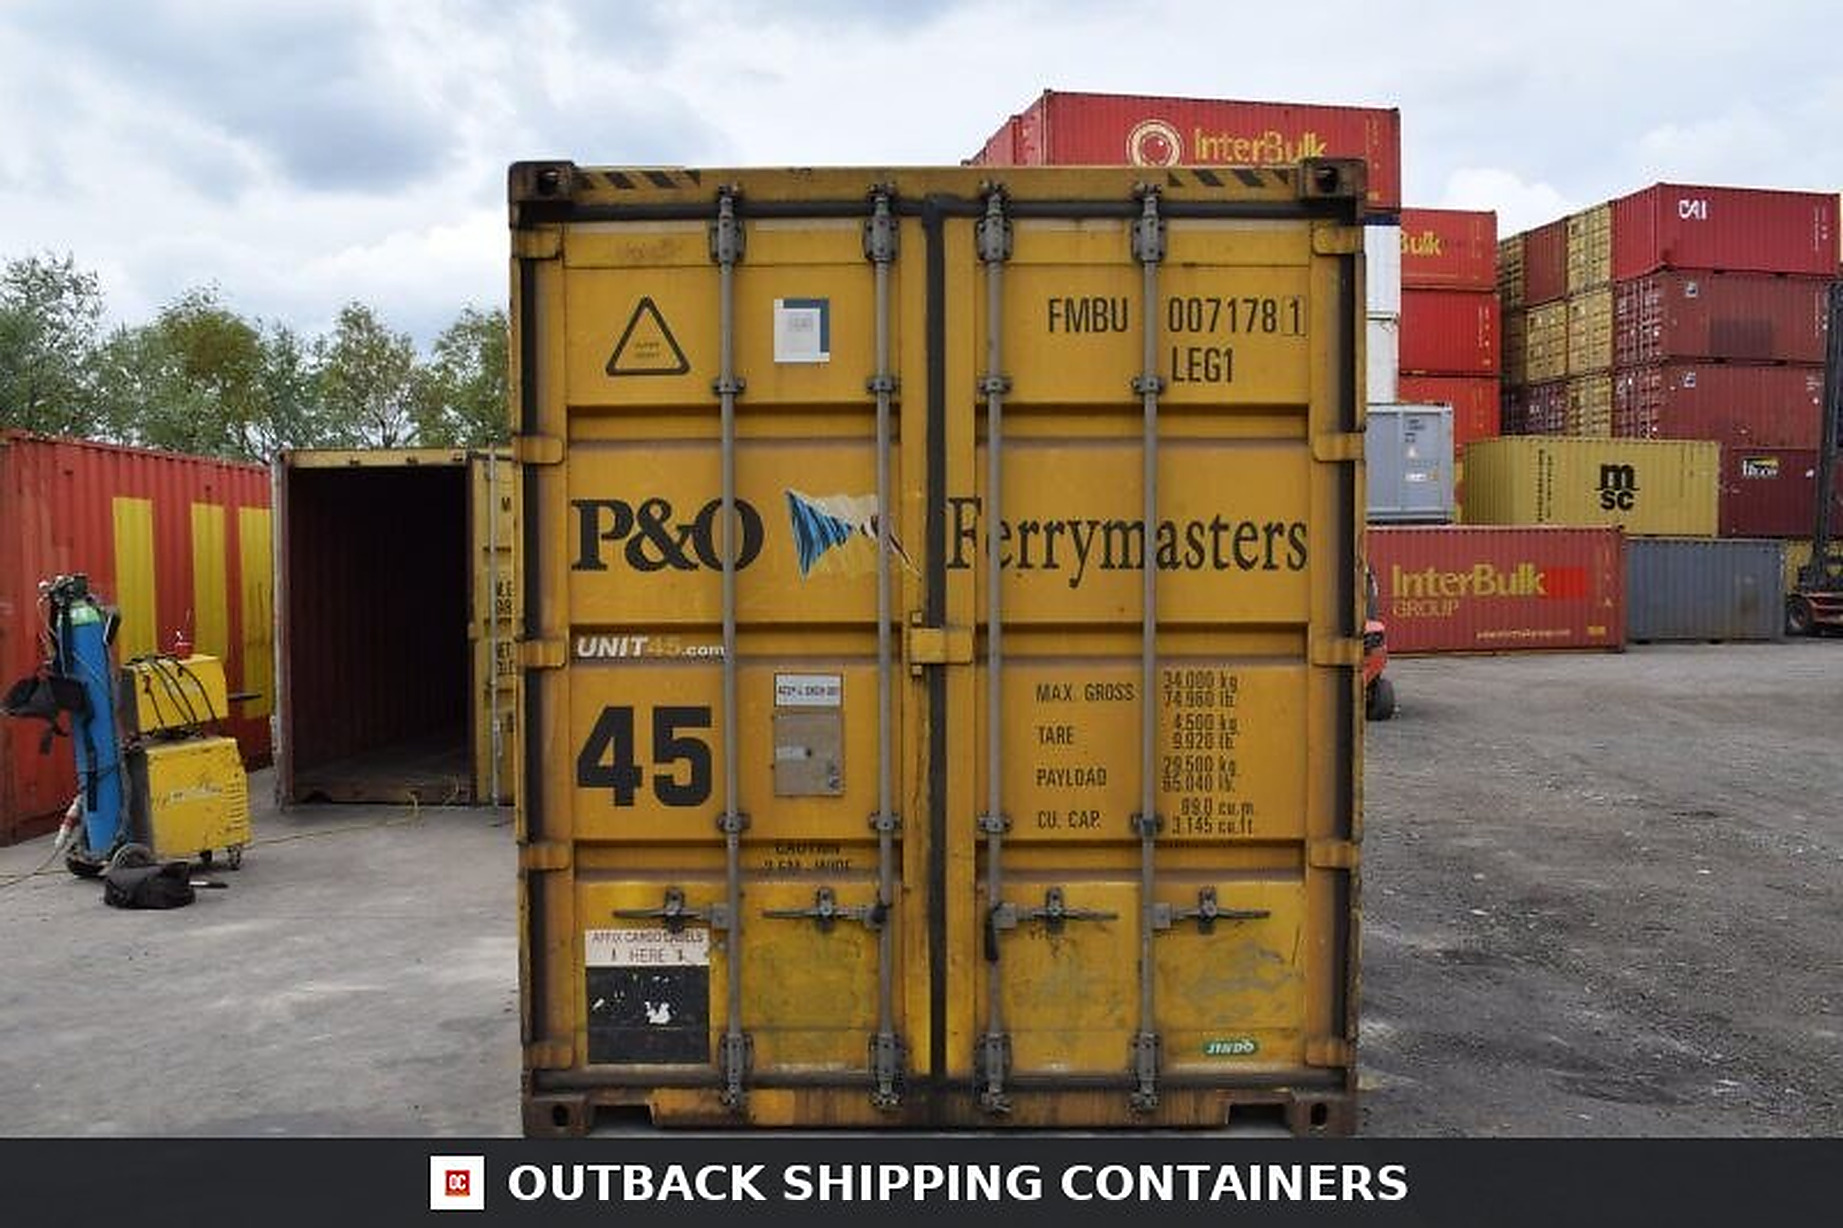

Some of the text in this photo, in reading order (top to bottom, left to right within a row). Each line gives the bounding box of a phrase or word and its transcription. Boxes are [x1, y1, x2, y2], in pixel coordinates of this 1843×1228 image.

[1194, 128, 1328, 164] InterBulk
[1048, 298, 1300, 334] FMBU 007178 1
[1172, 348, 1233, 382] LEG1
[570, 496, 1308, 589] P&O Ferrymasters
[1392, 563, 1549, 599] InterBulk
[1036, 683, 1135, 702] MAX GROSS
[1038, 726, 1074, 744] TARE
[577, 706, 713, 808] 45
[1036, 768, 1107, 787] PAYLOAD
[629, 949, 665, 962] HERE
